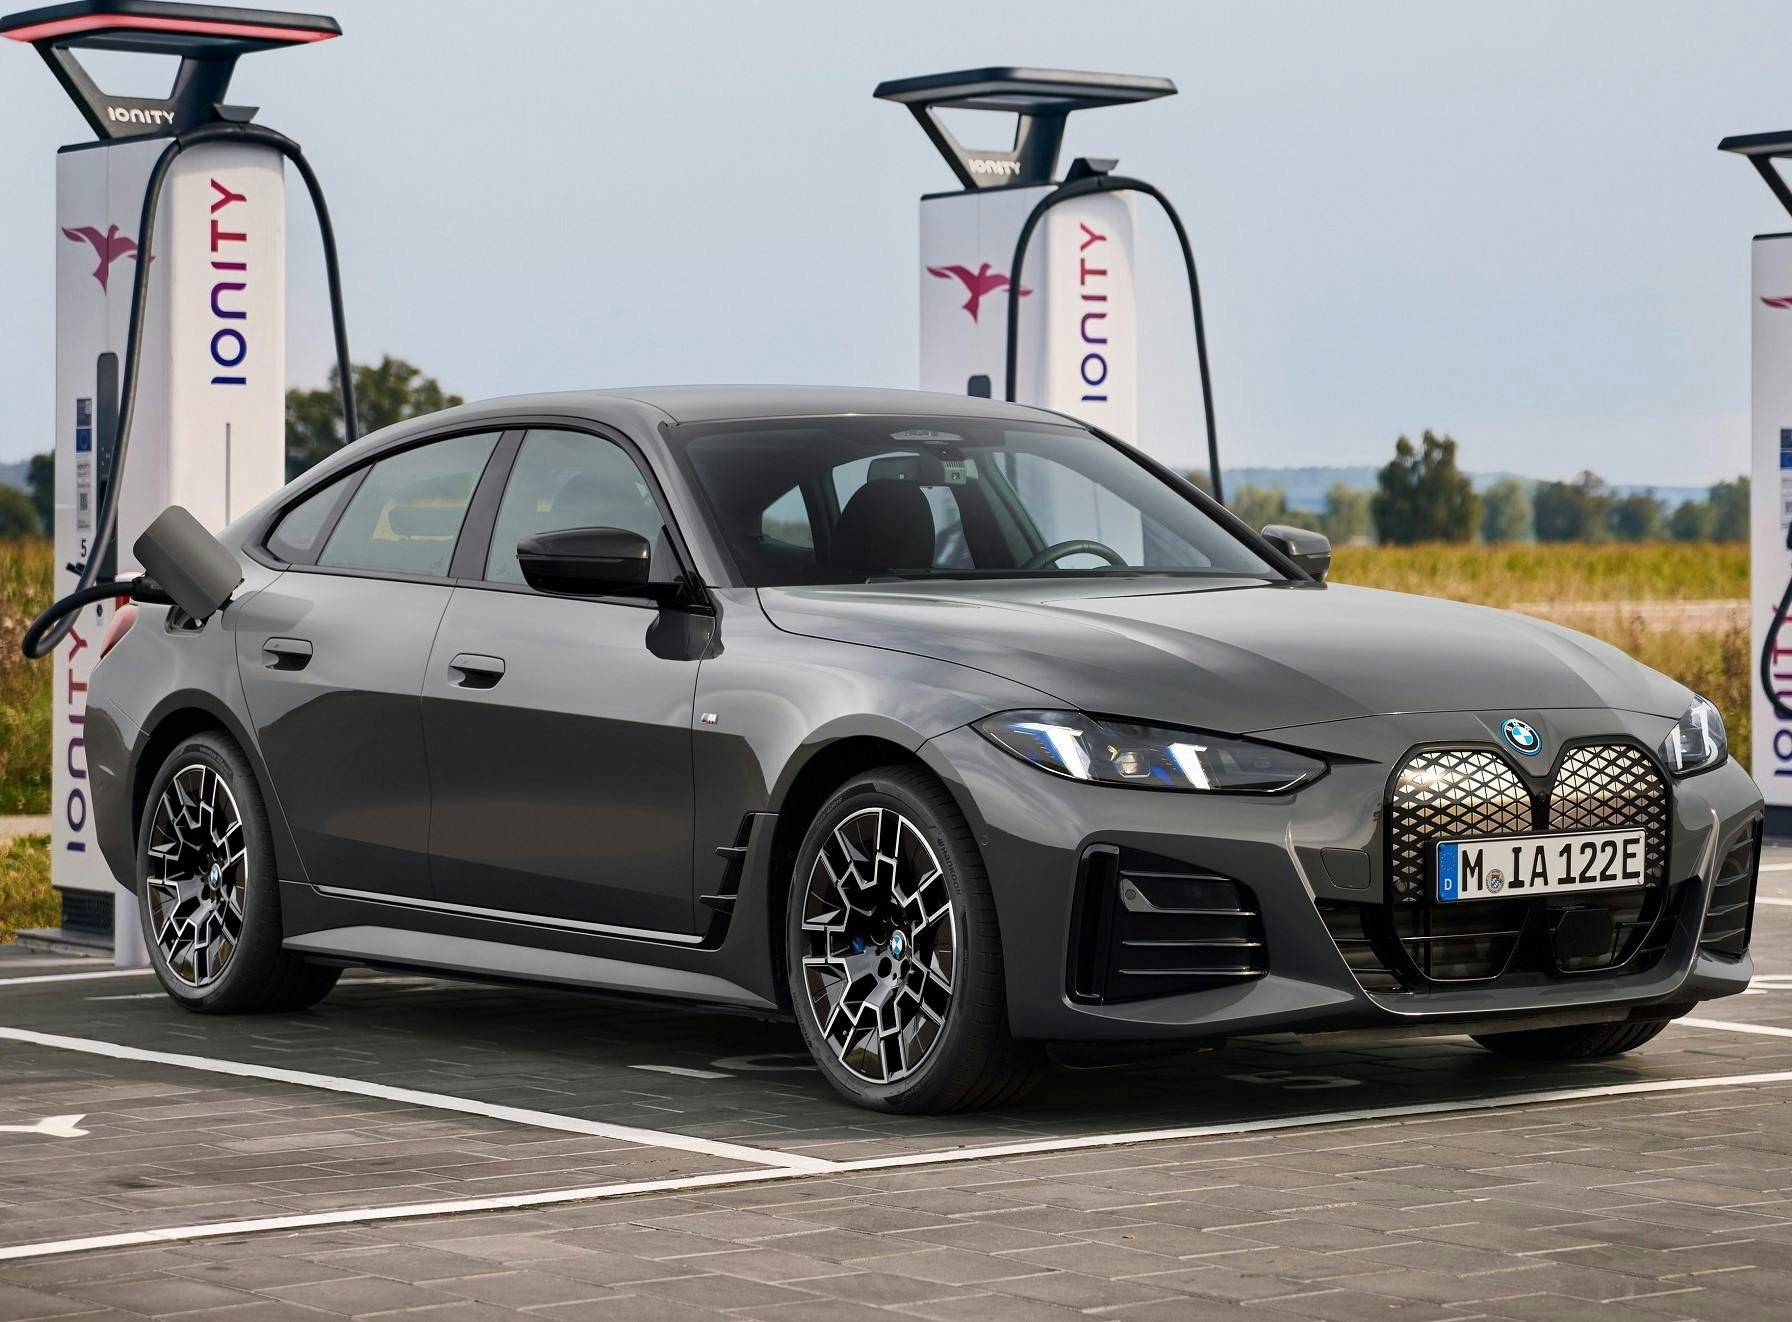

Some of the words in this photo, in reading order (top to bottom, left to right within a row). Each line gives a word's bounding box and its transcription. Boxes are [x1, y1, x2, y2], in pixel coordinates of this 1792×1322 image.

[107, 106, 174, 125] IONITY
[968, 159, 1020, 176] IONITY
[210, 178, 247, 385] IONITY
[1080, 222, 1108, 402] IONITY
[80, 538, 87, 557] 5
[66, 626, 89, 853] IONITY
[1461, 848, 1483, 892] M
[1508, 845, 1549, 889] IA
[1557, 837, 1641, 885] 122E
[1444, 878, 1452, 891] D
